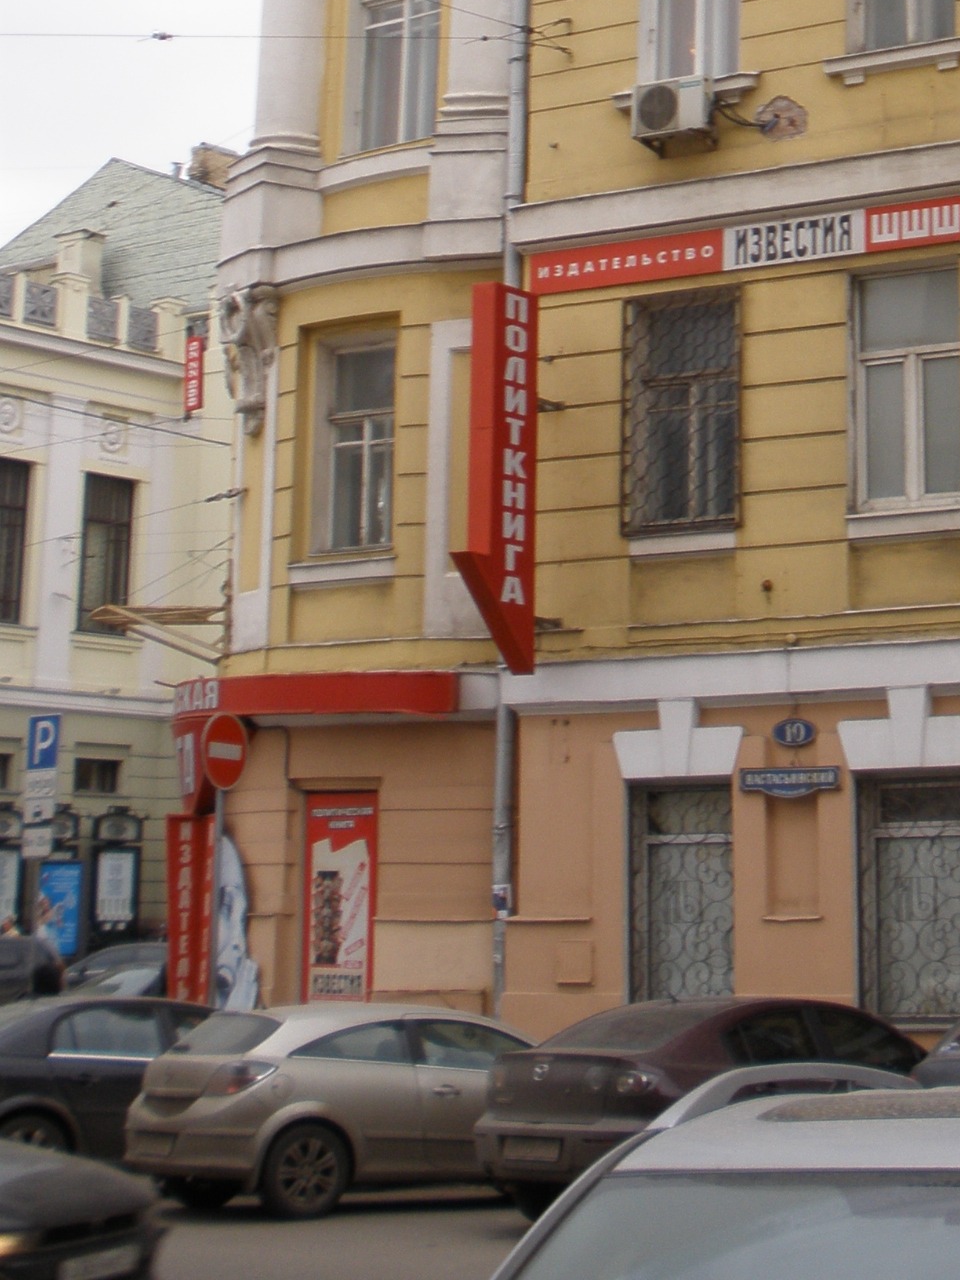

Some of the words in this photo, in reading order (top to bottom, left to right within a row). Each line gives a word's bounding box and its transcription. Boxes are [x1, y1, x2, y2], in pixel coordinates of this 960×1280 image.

[537, 246, 715, 280] ИЗДАТЕЛЬСТВО
[734, 214, 853, 266] ИЗВЕСТИЯ
[501, 291, 528, 605] ПОЛИТКНИГА
[33, 720, 56, 765] P
